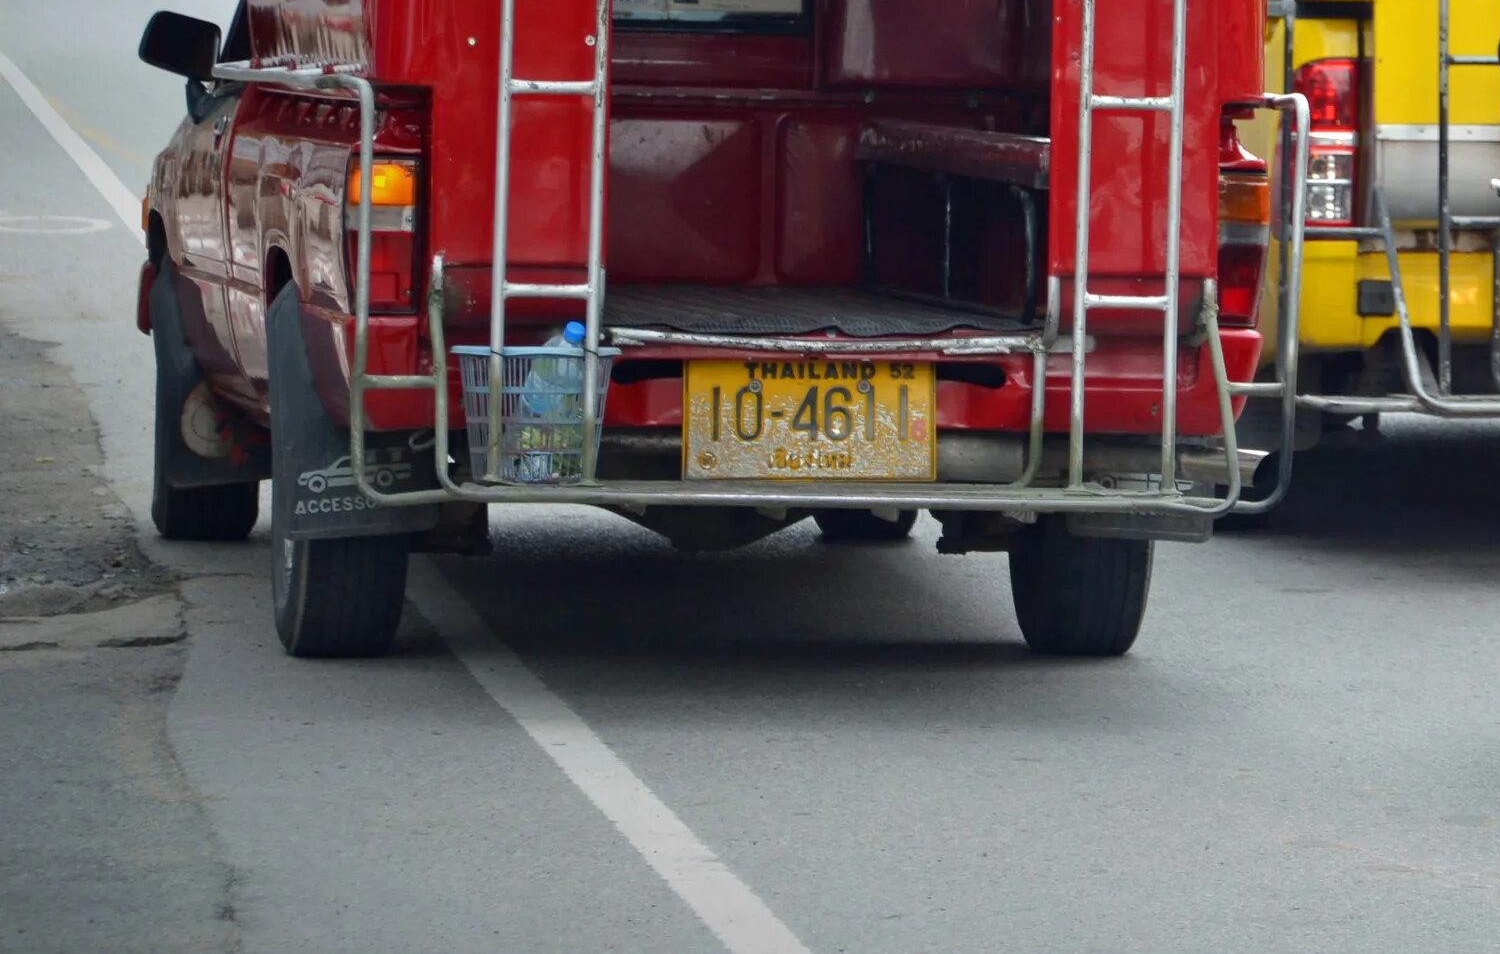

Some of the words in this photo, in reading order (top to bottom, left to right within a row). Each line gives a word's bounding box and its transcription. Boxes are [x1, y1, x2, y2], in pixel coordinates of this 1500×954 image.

[745, 362, 876, 380] THAILAND
[889, 365, 915, 379] 52
[711, 385, 908, 442] 10-4611
